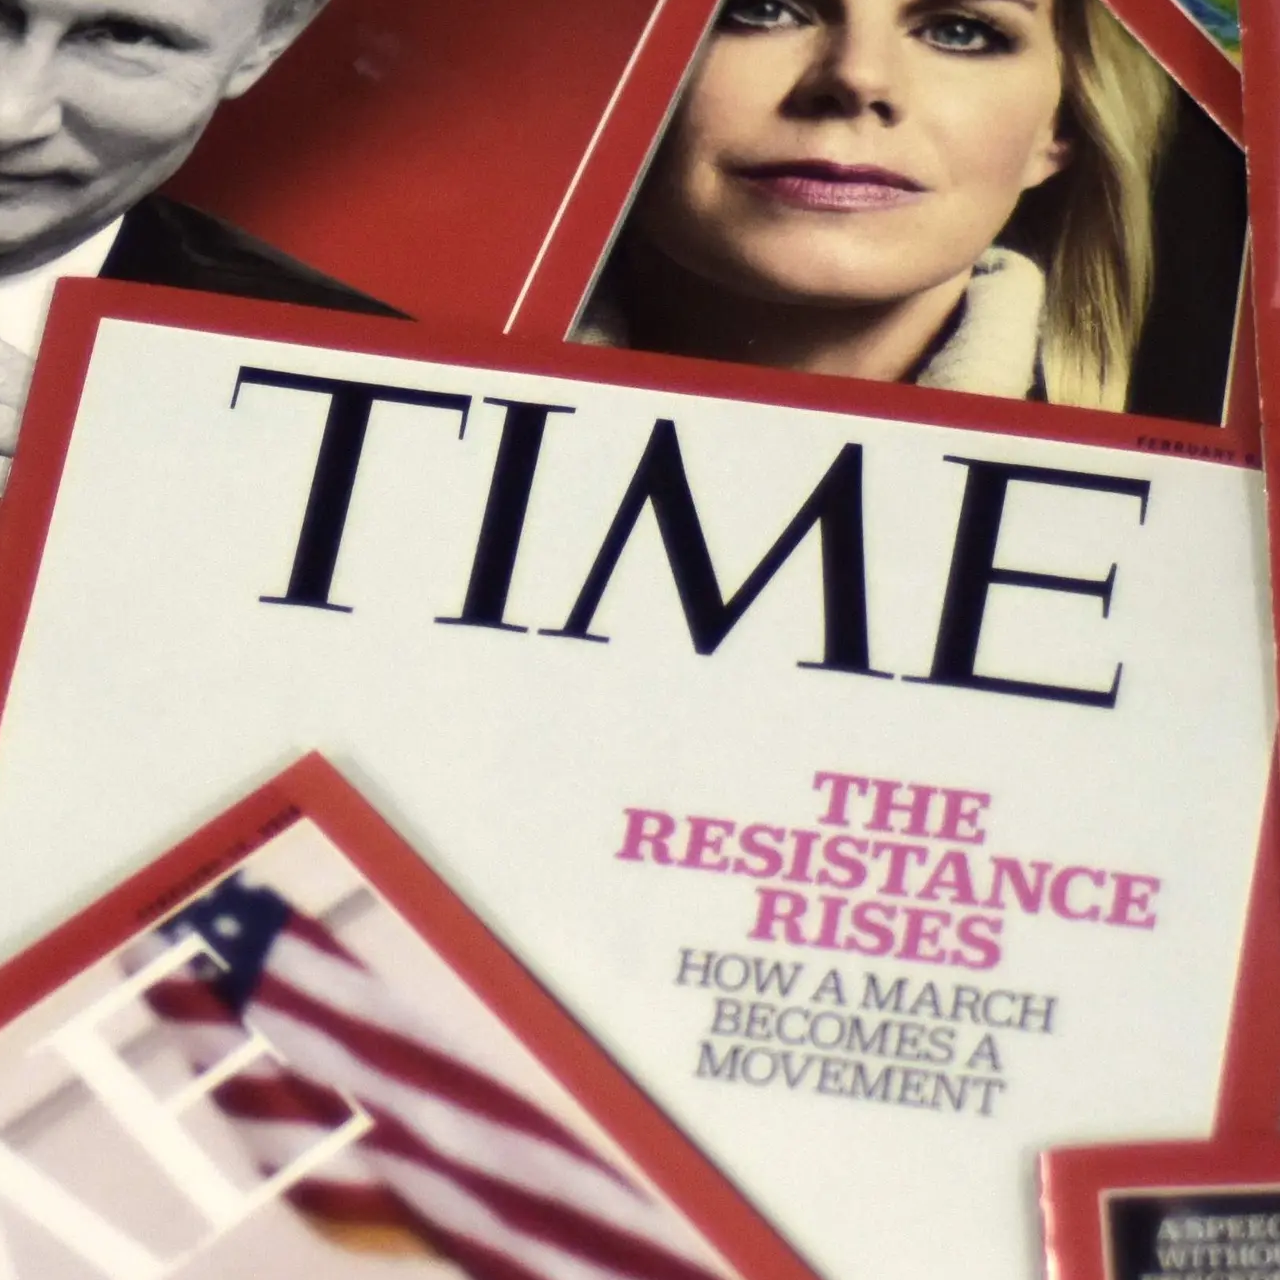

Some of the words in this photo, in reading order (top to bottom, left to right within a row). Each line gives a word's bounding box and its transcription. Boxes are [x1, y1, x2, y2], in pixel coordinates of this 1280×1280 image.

[231, 366, 1151, 709] TIME
[812, 769, 992, 845] THE
[615, 807, 1161, 931] RESISTANCE
[747, 887, 1005, 972] RISES
[674, 948, 804, 998] HOW
[812, 970, 847, 1006] A
[858, 972, 1059, 1035] MARCH
[709, 998, 956, 1066] BECOMES
[967, 1034, 1003, 1073] A
[694, 1041, 1007, 1118] MOVEMENT
